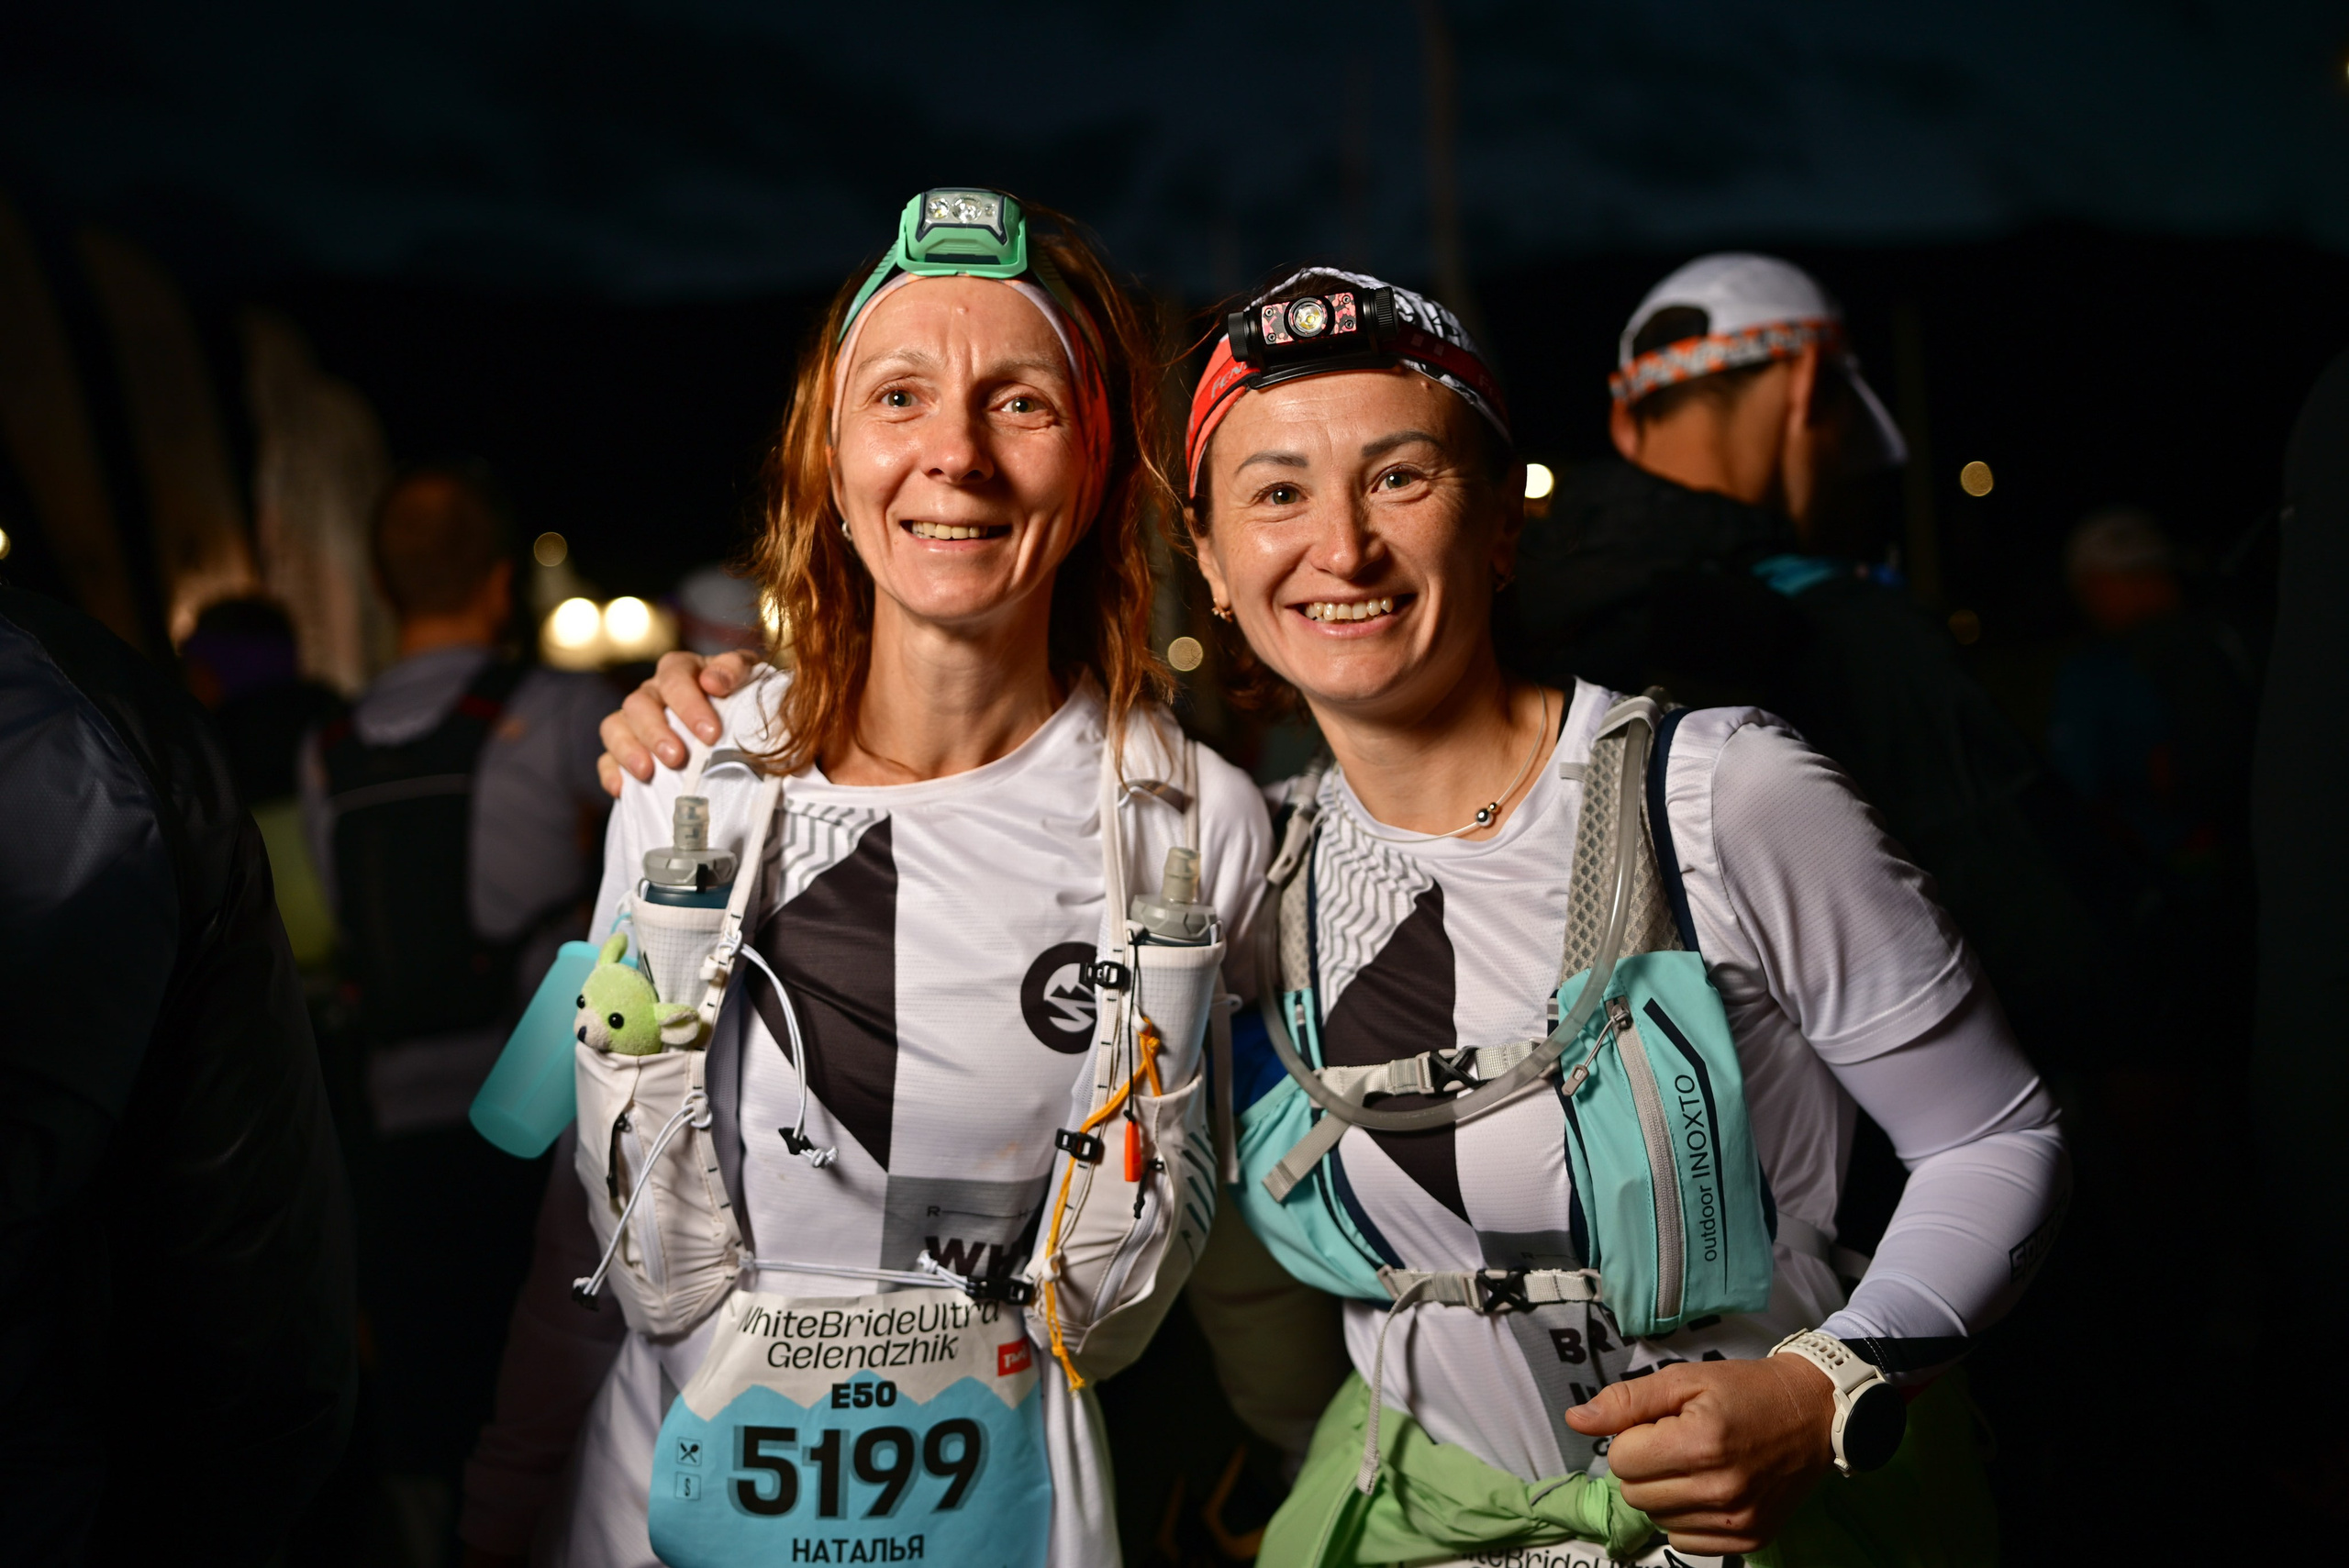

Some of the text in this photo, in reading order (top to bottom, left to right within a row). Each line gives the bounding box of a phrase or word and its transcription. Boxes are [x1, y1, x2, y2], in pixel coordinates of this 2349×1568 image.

[1675, 1073, 1717, 1262] outdoor INOXTO
[767, 1335, 958, 1369] Gelendzhik
[831, 1381, 896, 1410] E50
[733, 1418, 982, 1518] 5199
[793, 1534, 924, 1563] НАТАЛЬЯ
